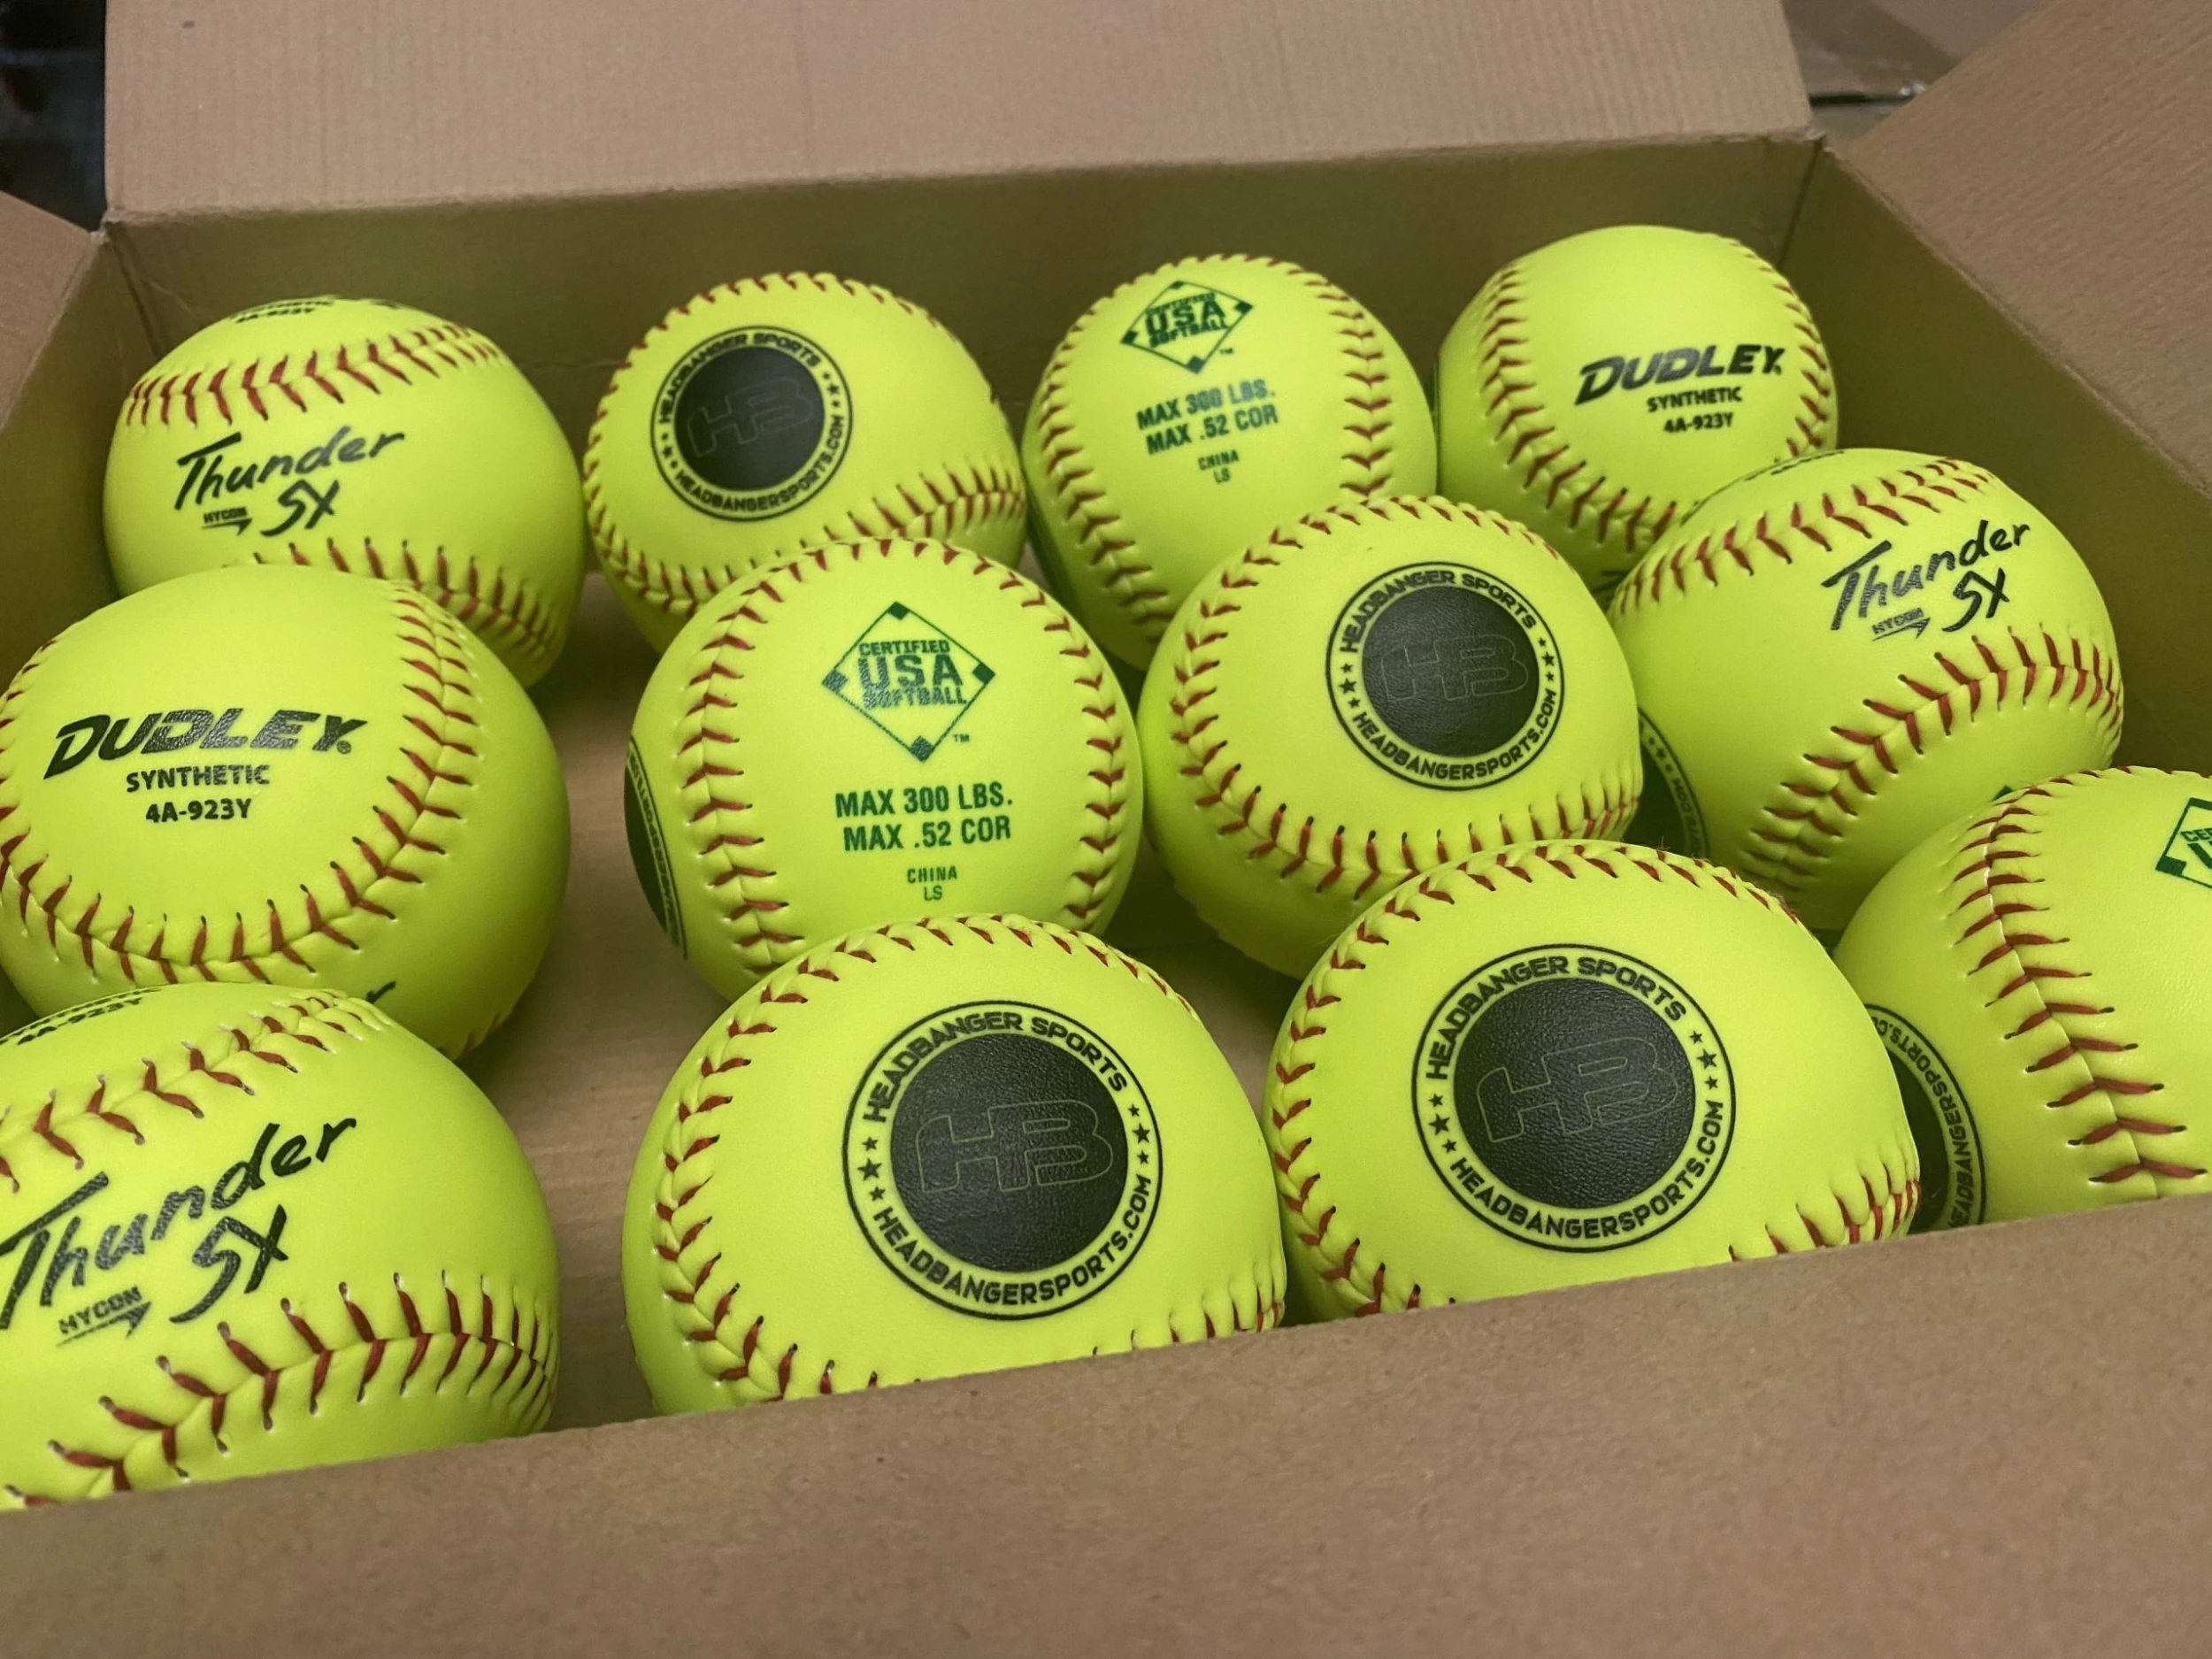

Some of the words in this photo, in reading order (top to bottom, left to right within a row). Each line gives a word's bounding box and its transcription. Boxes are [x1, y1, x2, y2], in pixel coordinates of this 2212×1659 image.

[1145, 301, 1225, 335] USA
[659, 334, 748, 423] HEADBANGER
[754, 333, 821, 367] SPORTS
[1647, 386, 1743, 412] SYNTHETIC
[1136, 398, 1182, 431] MAX
[1186, 388, 1223, 415] 300
[1227, 379, 1276, 404] LBS.
[1663, 411, 1733, 434] 4A-923Y
[1146, 423, 1193, 455] MAX
[1200, 414, 1229, 440] .52
[1234, 403, 1279, 431] COR
[174, 426, 404, 510] Thunder
[675, 415, 844, 511] HEADBANGERSPORTS.COM
[1198, 449, 1239, 471] CHINA
[1213, 468, 1230, 484] LS
[1821, 519, 2030, 631] Thunder
[1340, 570, 1456, 653] HEADBANGER
[1461, 573, 1537, 629] SPORTS
[859, 639, 950, 657] CERTIFIED
[857, 653, 964, 689] USA
[862, 685, 967, 710] SOFTBALL
[1352, 688, 1556, 780] HEADBANGERSPORTS.COM
[126, 764, 270, 793] SYNTHETIC
[835, 788, 895, 818] MAX
[903, 786, 949, 814] 300
[958, 781, 1013, 810] LBS.
[146, 798, 252, 823] 4A-923Y
[843, 823, 904, 851] MAX
[914, 820, 952, 849] .52
[961, 815, 1011, 844] COR
[907, 865, 957, 884] CHINA
[924, 885, 942, 902] LS
[1425, 956, 1570, 1079] HEADBANGER
[1577, 956, 1686, 1021] SPORTS
[863, 1011, 1023, 1123] HEADBANGER
[1031, 1017, 1127, 1092] SPORTS
[1450, 1100, 1724, 1239] HEADBANGERSPORTS.COM
[0, 1118, 357, 1329] Thunder
[873, 1173, 1151, 1306] HEADBANGERSPORTS.COM
[58, 1286, 142, 1335] HYCON
